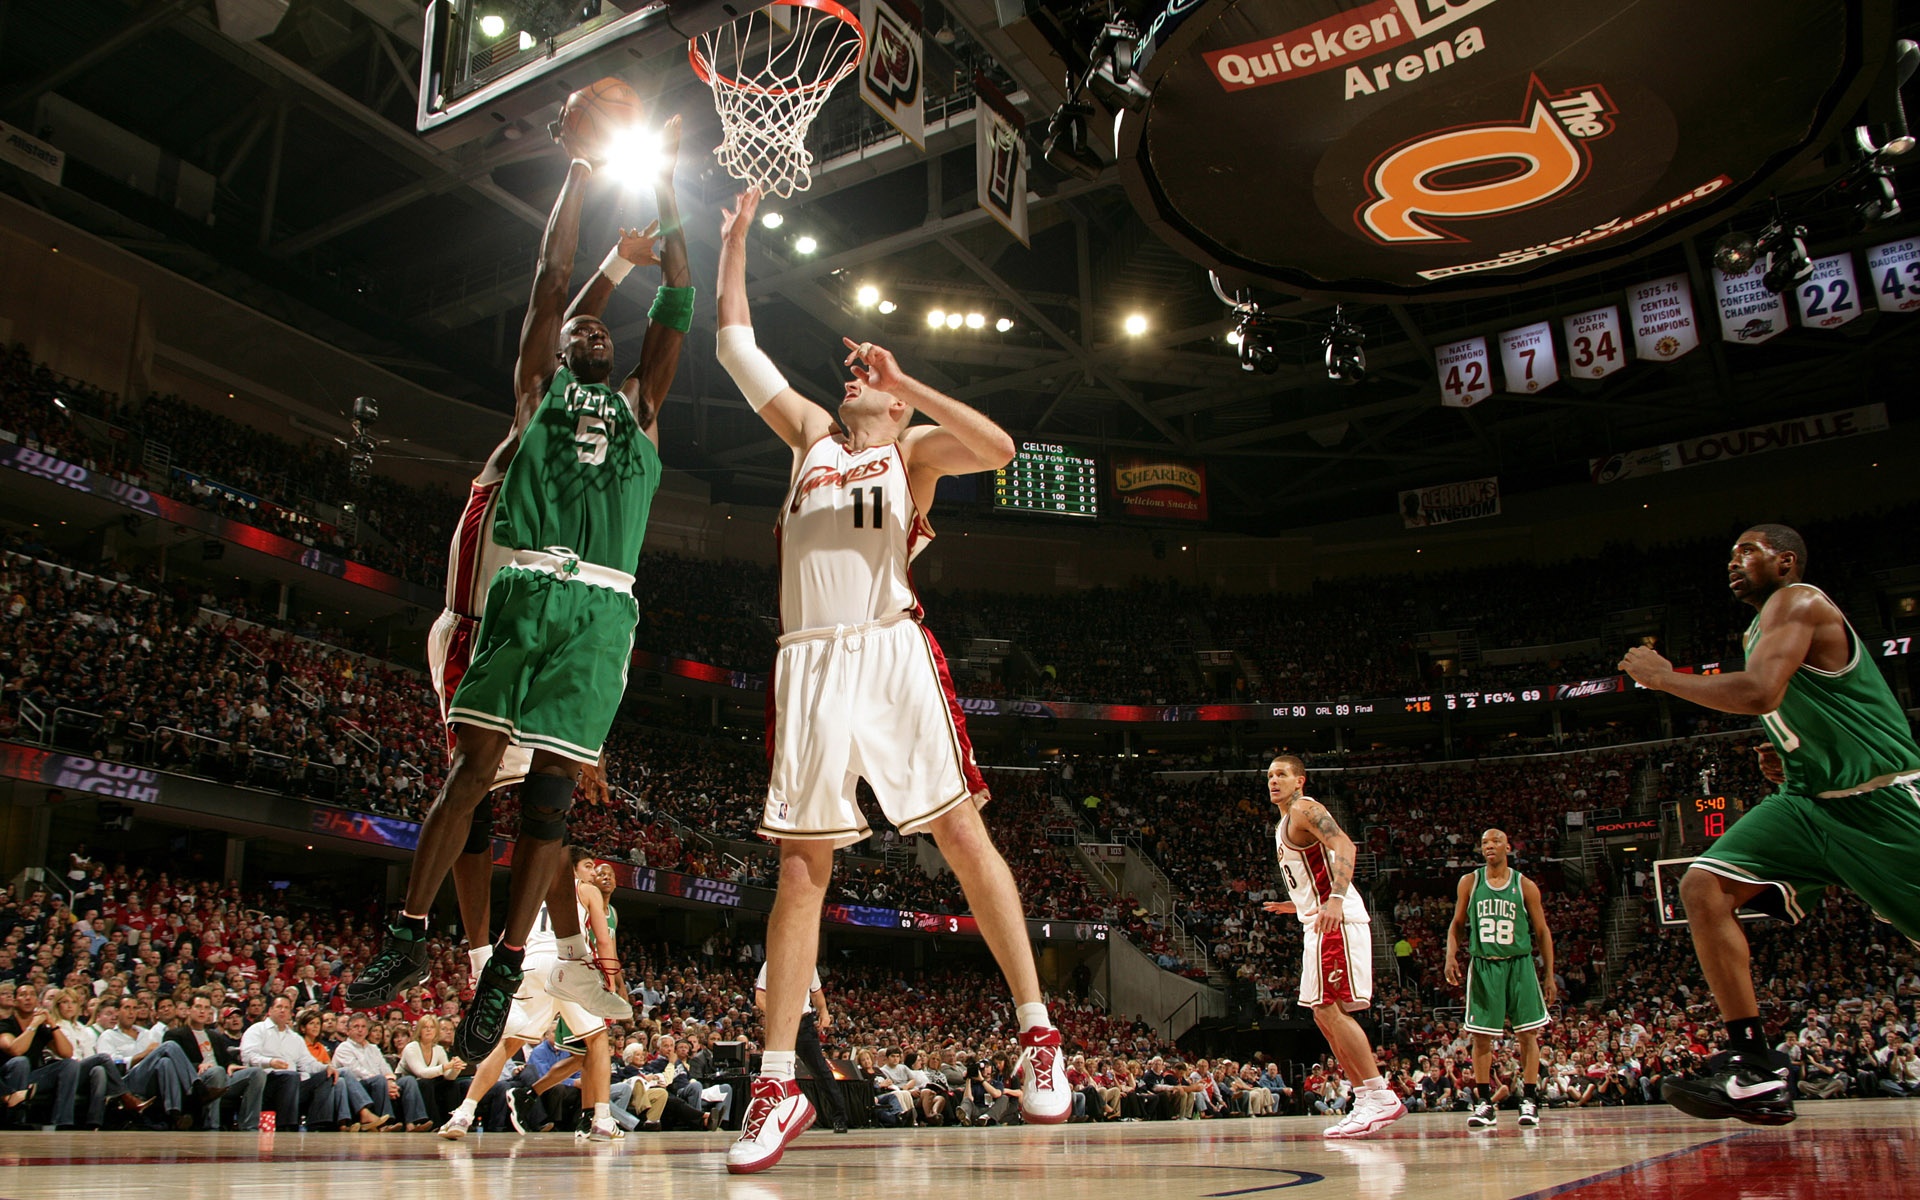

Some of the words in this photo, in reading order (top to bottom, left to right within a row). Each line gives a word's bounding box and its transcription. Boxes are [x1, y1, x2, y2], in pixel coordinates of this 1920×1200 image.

[1217, 12, 1401, 85] Quicken
[1345, 26, 1486, 100] Arena
[1550, 90, 1604, 137] The
[7, 134, 57, 166] Allstate
[1882, 242, 1913, 256] BRAD
[1813, 259, 1840, 272] ARRY
[1809, 268, 1843, 281] ANCE
[1881, 262, 1920, 300] 43
[1637, 282, 1679, 300] 1975-76
[1726, 279, 1764, 295] EASTER
[1641, 296, 1680, 312] CENTRAL
[1720, 289, 1778, 308] CONFERENC
[1803, 279, 1853, 318] 22
[1643, 308, 1681, 323] DIVISION
[1724, 300, 1779, 319] CHAMPIONS
[1572, 312, 1608, 326] AUSTIN
[1578, 322, 1605, 334] CARR
[1639, 318, 1690, 337] CHAMPIONS
[1448, 343, 1472, 355] NATE
[1511, 337, 1541, 350] SMITH
[1573, 331, 1617, 367] 34
[1439, 349, 1484, 366] THURMOND
[1519, 349, 1536, 380] 7
[1445, 362, 1485, 395] 42
[575, 415, 609, 467] 5
[1677, 412, 1858, 466] LOUDVILLE
[1022, 442, 1064, 453] CELTICS
[15, 448, 88, 482] BUD
[1032, 453, 1043, 461] AS
[1045, 455, 1063, 463] FG%
[1065, 457, 1082, 465] FT%
[1090, 467, 1095, 475] 0
[1120, 468, 1198, 489] SHEARER'S
[997, 488, 1006, 496] 41
[1027, 490, 1032, 498] 0
[1090, 496, 1096, 504] 0
[1079, 485, 1084, 493] 0
[1090, 486, 1095, 494] 0
[1421, 481, 1497, 509] LEBRON'S
[850, 486, 883, 529] 11
[1123, 495, 1165, 508] Delicious
[1167, 497, 1198, 510] Snacks
[1424, 500, 1496, 524] KINGDOM
[1882, 637, 1911, 656] 27
[1447, 699, 1456, 710] 5
[1466, 698, 1476, 709] 2
[1484, 692, 1515, 704] FG%
[1521, 690, 1541, 702] 69
[1273, 707, 1288, 716] DET
[1292, 706, 1306, 717] 90
[1315, 707, 1332, 715] ORL
[1335, 705, 1349, 716] 89
[1354, 705, 1373, 713] Final
[1405, 701, 1431, 712] +18
[1695, 797, 1725, 812] 5:40
[1596, 820, 1656, 832] PONTIAC
[1704, 813, 1724, 837] 18
[1477, 899, 1516, 920] CELTICS
[902, 919, 911, 928] 69
[950, 918, 958, 933] 3
[1042, 923, 1050, 938] 1
[1480, 918, 1514, 945] 28
[1095, 932, 1106, 940] 43
